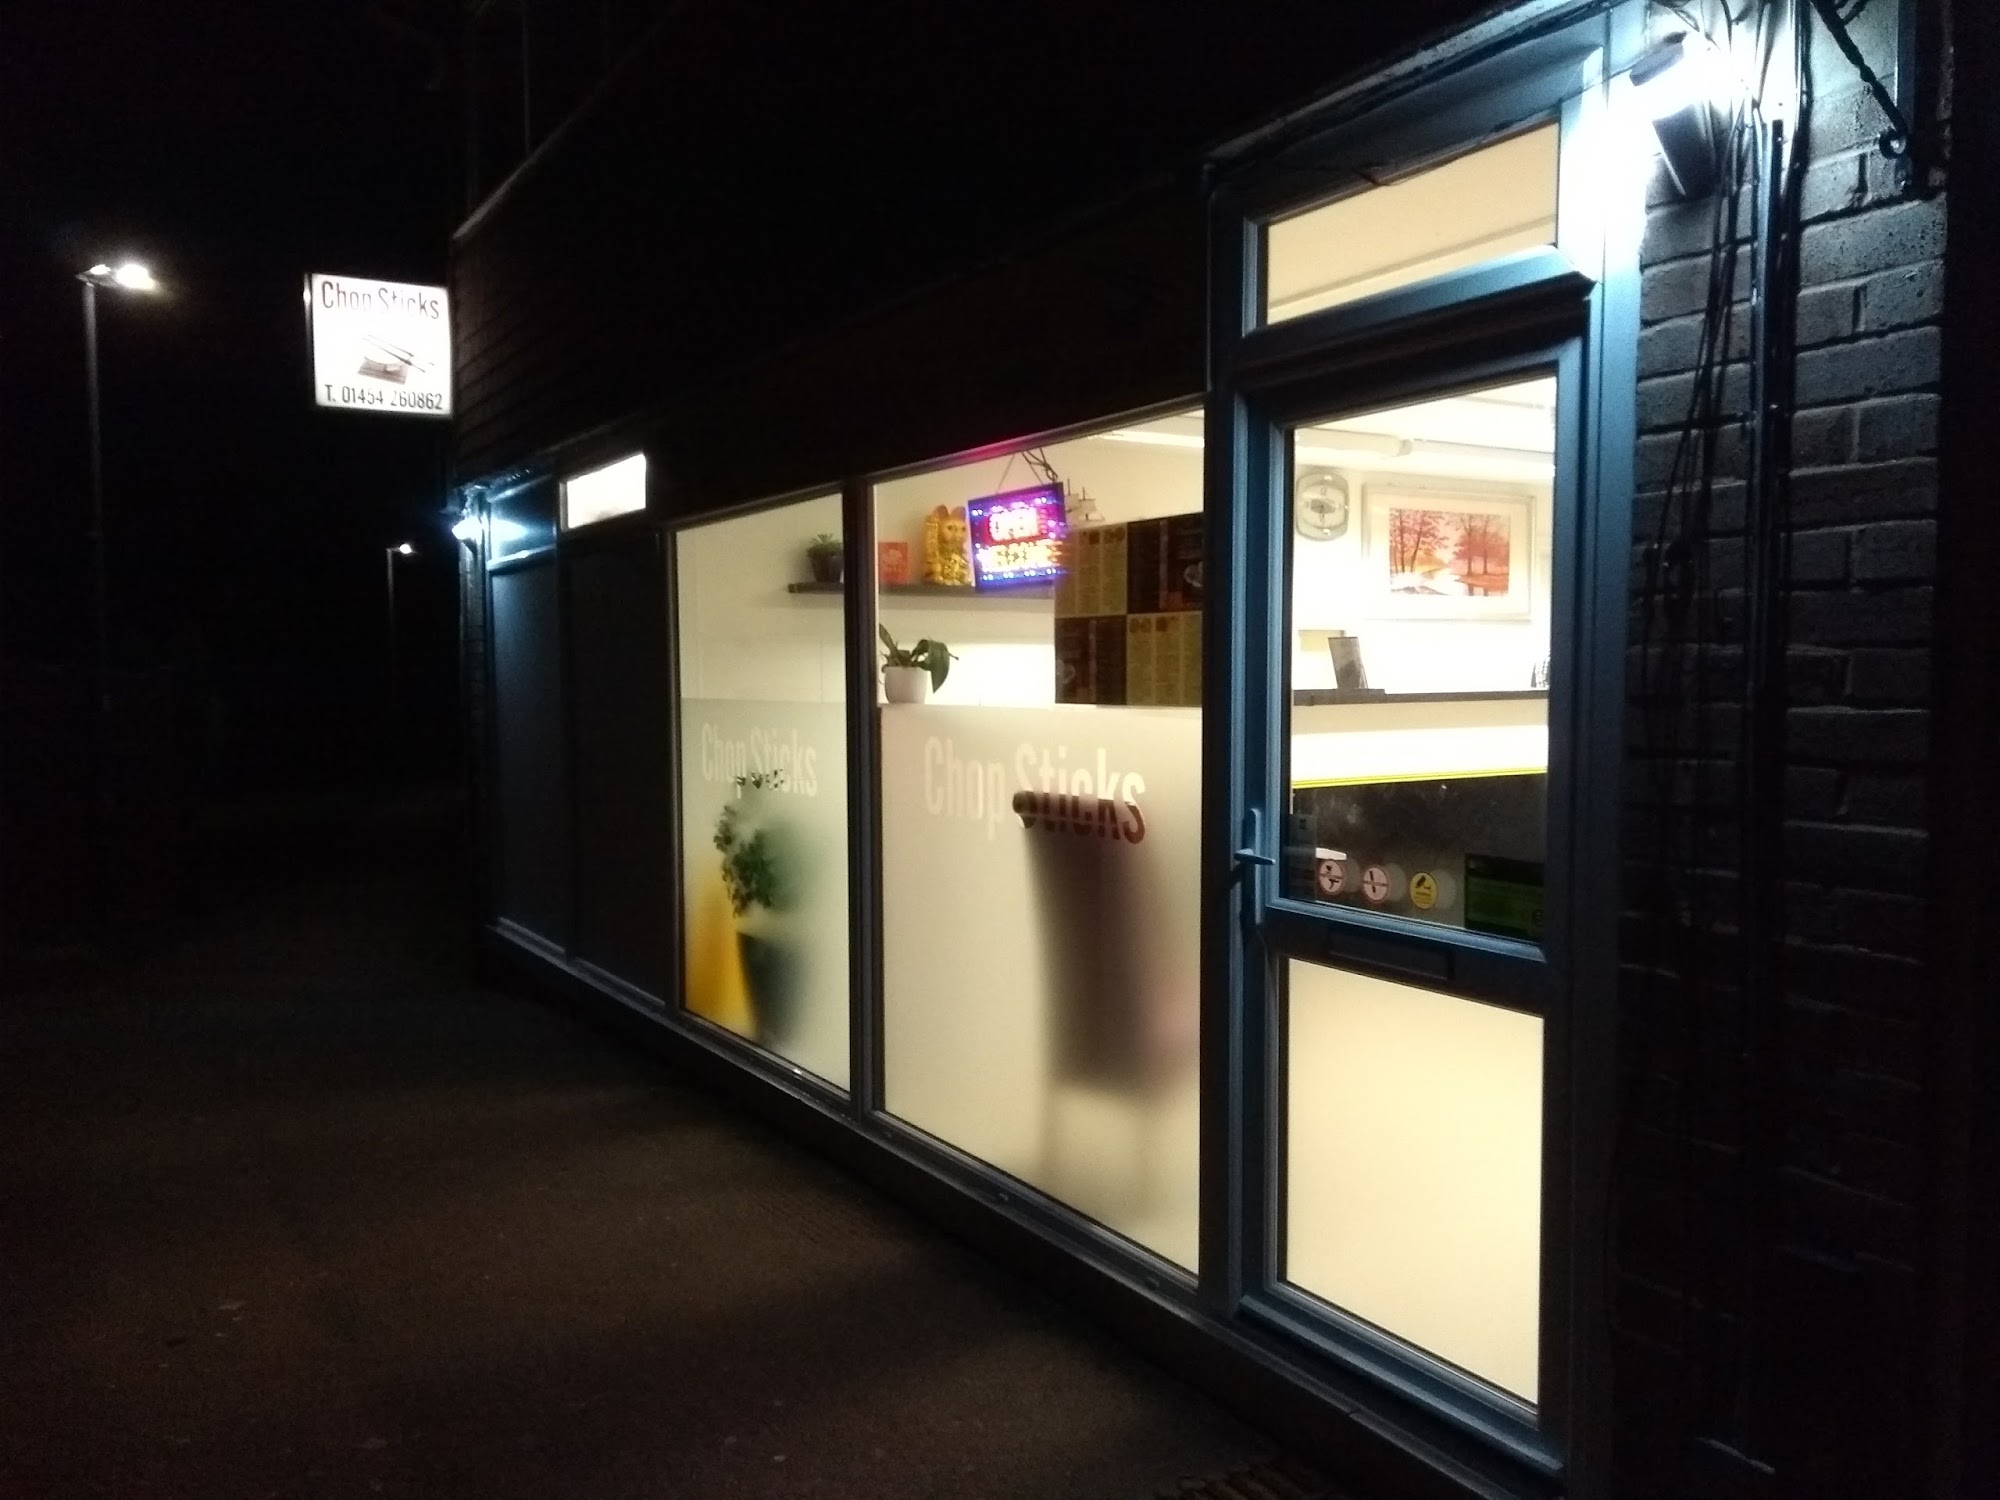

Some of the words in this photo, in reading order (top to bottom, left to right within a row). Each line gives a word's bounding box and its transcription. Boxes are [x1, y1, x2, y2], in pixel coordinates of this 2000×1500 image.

[378, 287, 440, 320] Sticks
[341, 386, 384, 405] 01454
[390, 390, 444, 410] 260862
[701, 722, 747, 800] Chop
[749, 725, 818, 798] Sticks
[923, 735, 1006, 841] Chop
[1012, 742, 1147, 845] Sticks
